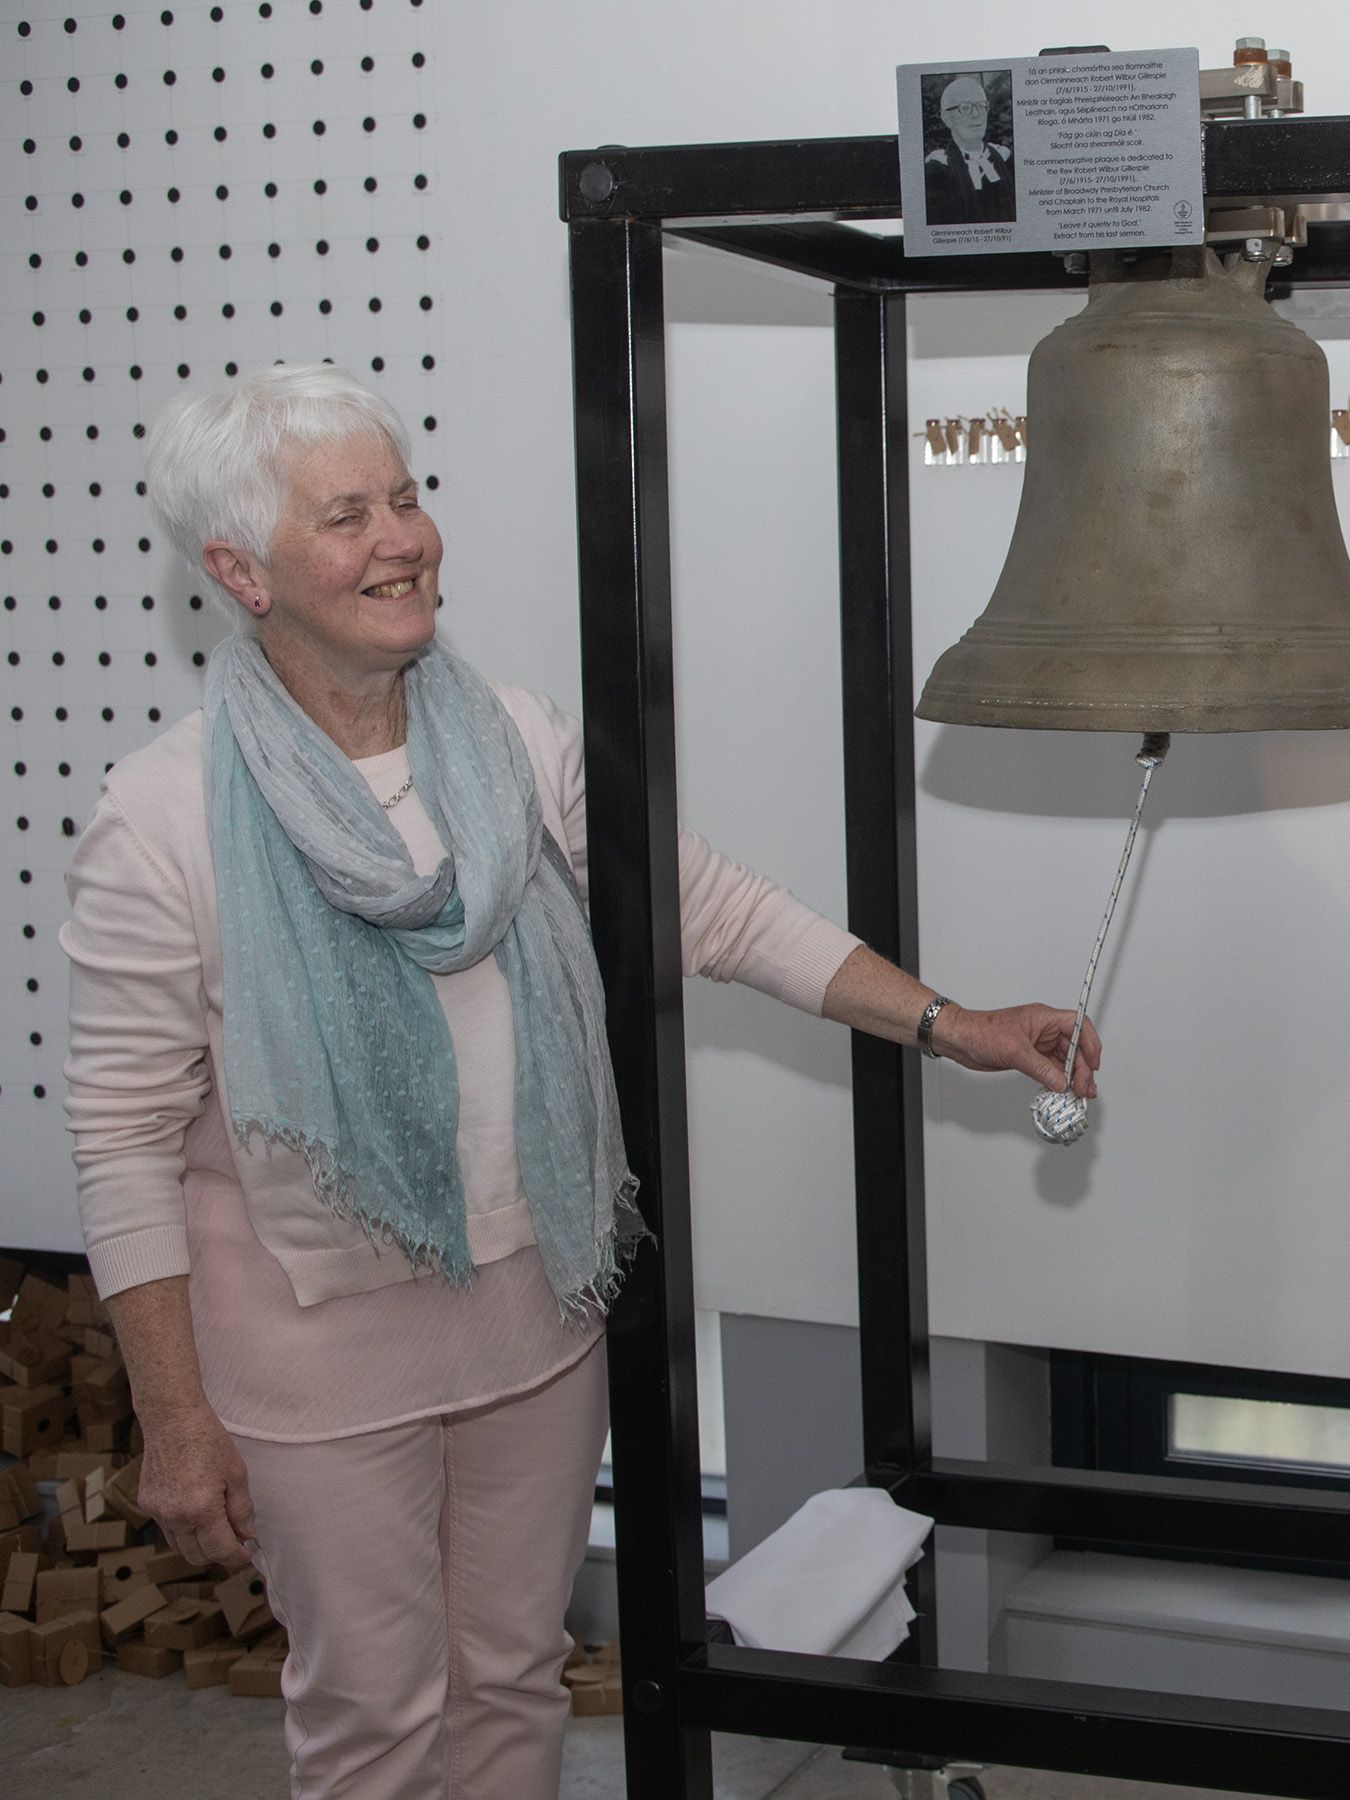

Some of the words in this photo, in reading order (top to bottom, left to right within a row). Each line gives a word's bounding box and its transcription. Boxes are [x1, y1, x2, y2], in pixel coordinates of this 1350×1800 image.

[1138, 72, 1166, 81] Gillespie
[1049, 97, 1072, 106] Eaglais
[1142, 92, 1176, 101] Bhealaigh
[1129, 103, 1168, 111] nOtharlann
[1036, 157, 1093, 166] commemorative
[1095, 156, 1119, 164] plaque
[1121, 164, 1149, 173] Gillespie
[1064, 187, 1099, 196] Broadway
[1100, 185, 1142, 194] Presbyterian
[1054, 197, 1086, 206] Chaplain
[1109, 196, 1128, 204] Royal
[1130, 194, 1160, 203] Hospitals
[1088, 221, 1111, 229] quietly
